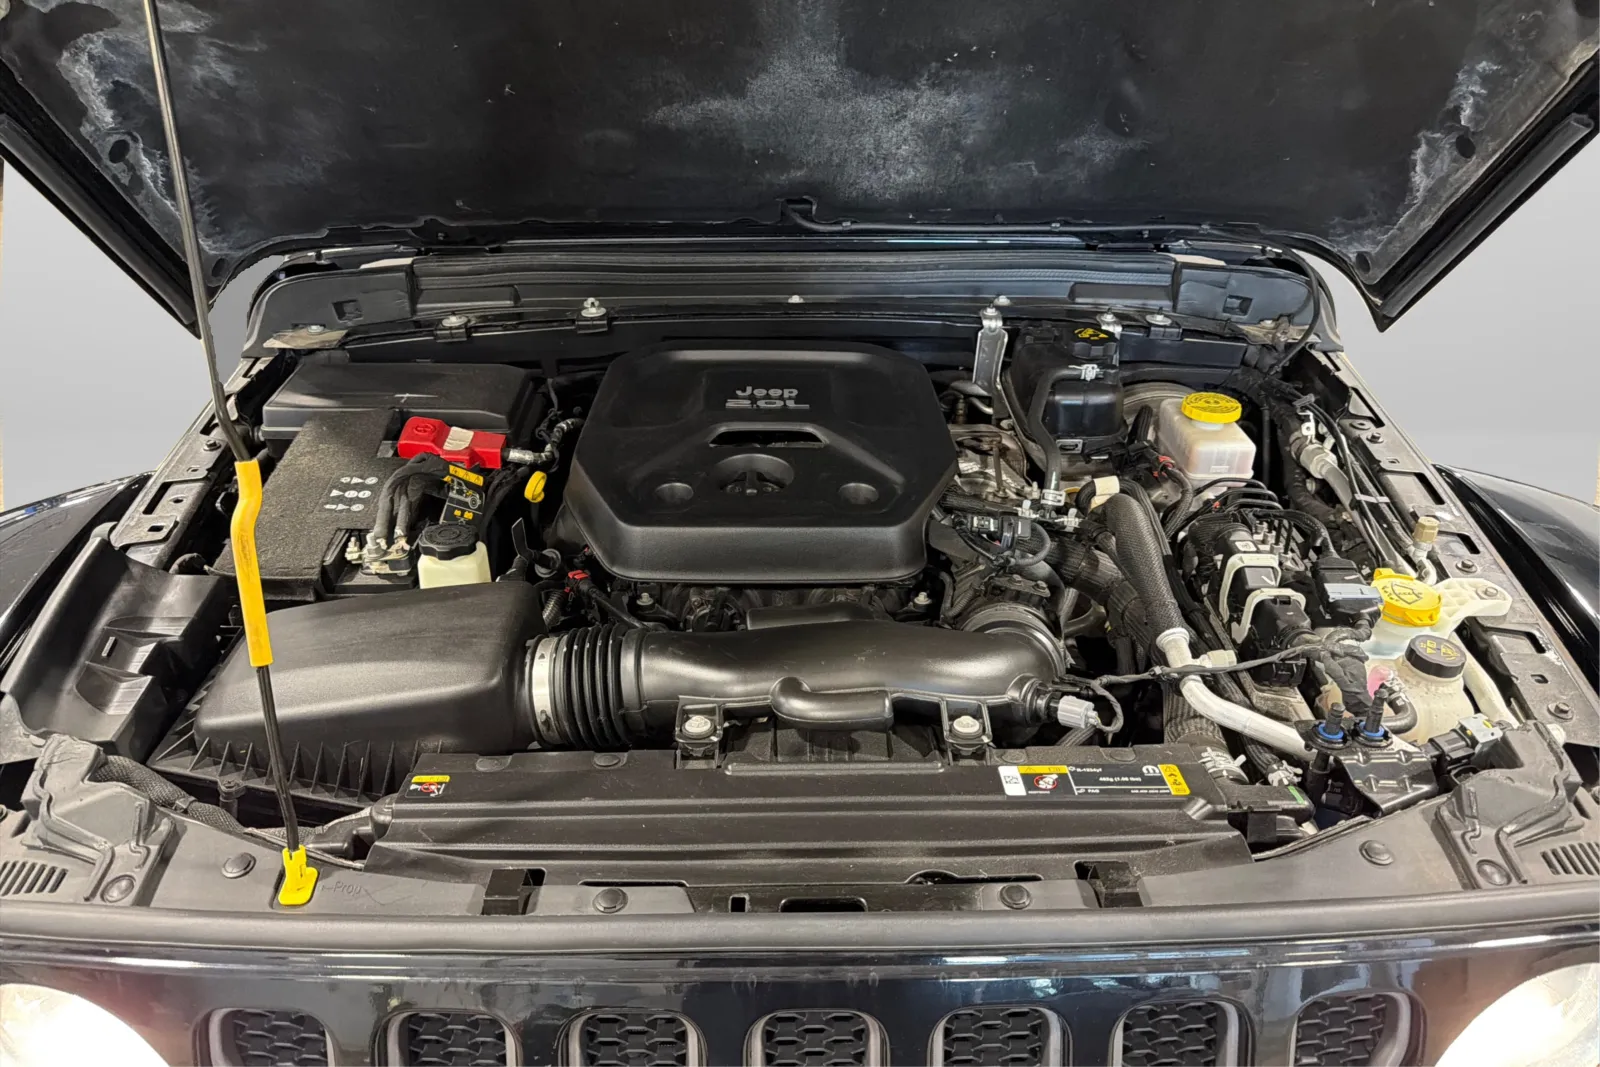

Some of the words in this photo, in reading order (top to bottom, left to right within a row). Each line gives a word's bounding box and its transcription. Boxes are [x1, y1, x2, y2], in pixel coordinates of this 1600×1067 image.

[735, 386, 799, 398] Jeep
[725, 399, 810, 409] 2.0L
[333, 881, 363, 897] Prop
